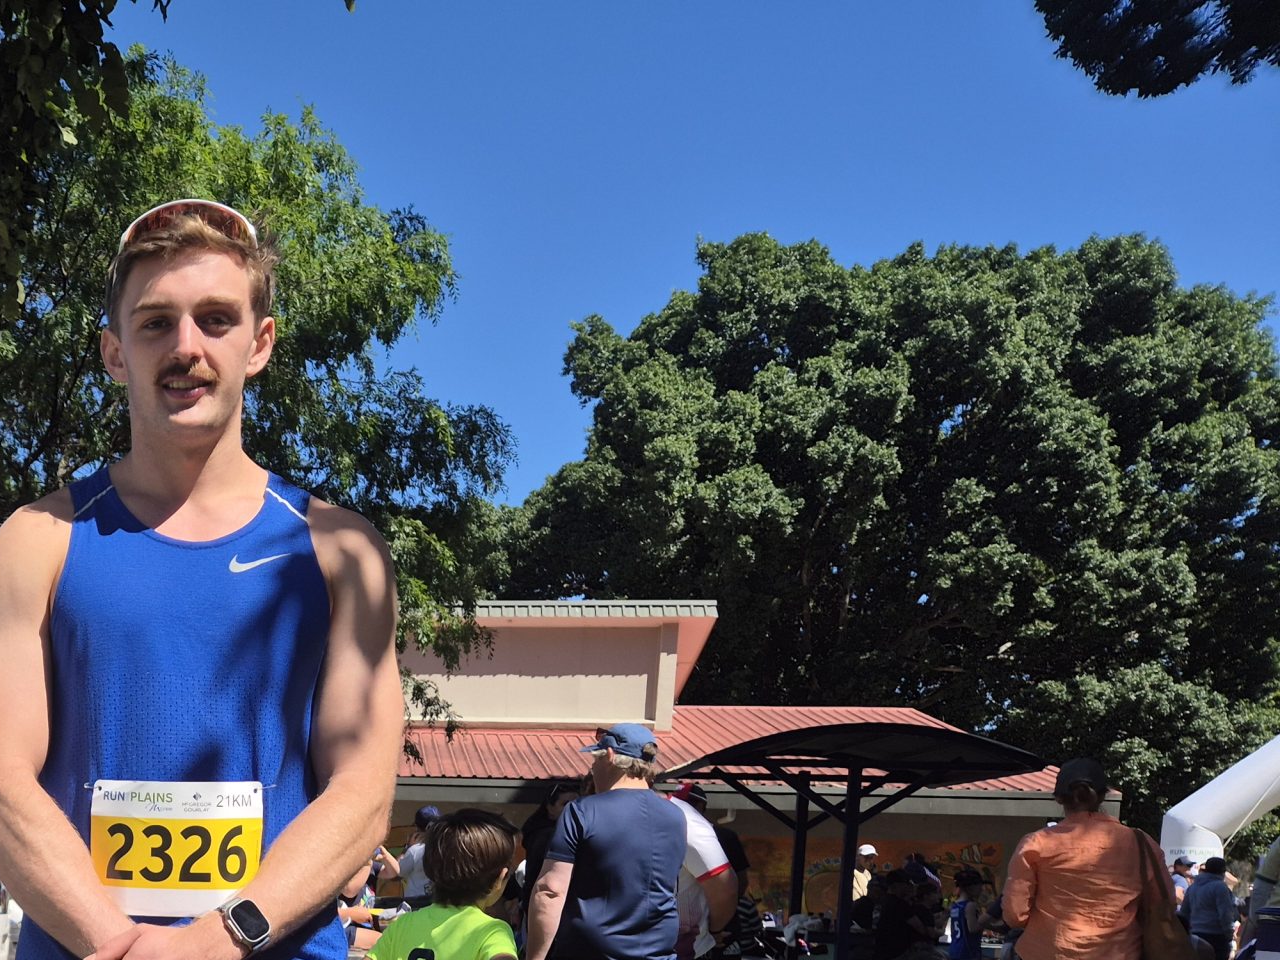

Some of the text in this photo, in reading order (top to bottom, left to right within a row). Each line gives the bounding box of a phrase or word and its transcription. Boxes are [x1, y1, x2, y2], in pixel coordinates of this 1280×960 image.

[103, 790, 173, 804] RUN PLAINS
[216, 794, 252, 808] 21KM
[105, 822, 247, 883] 2326
